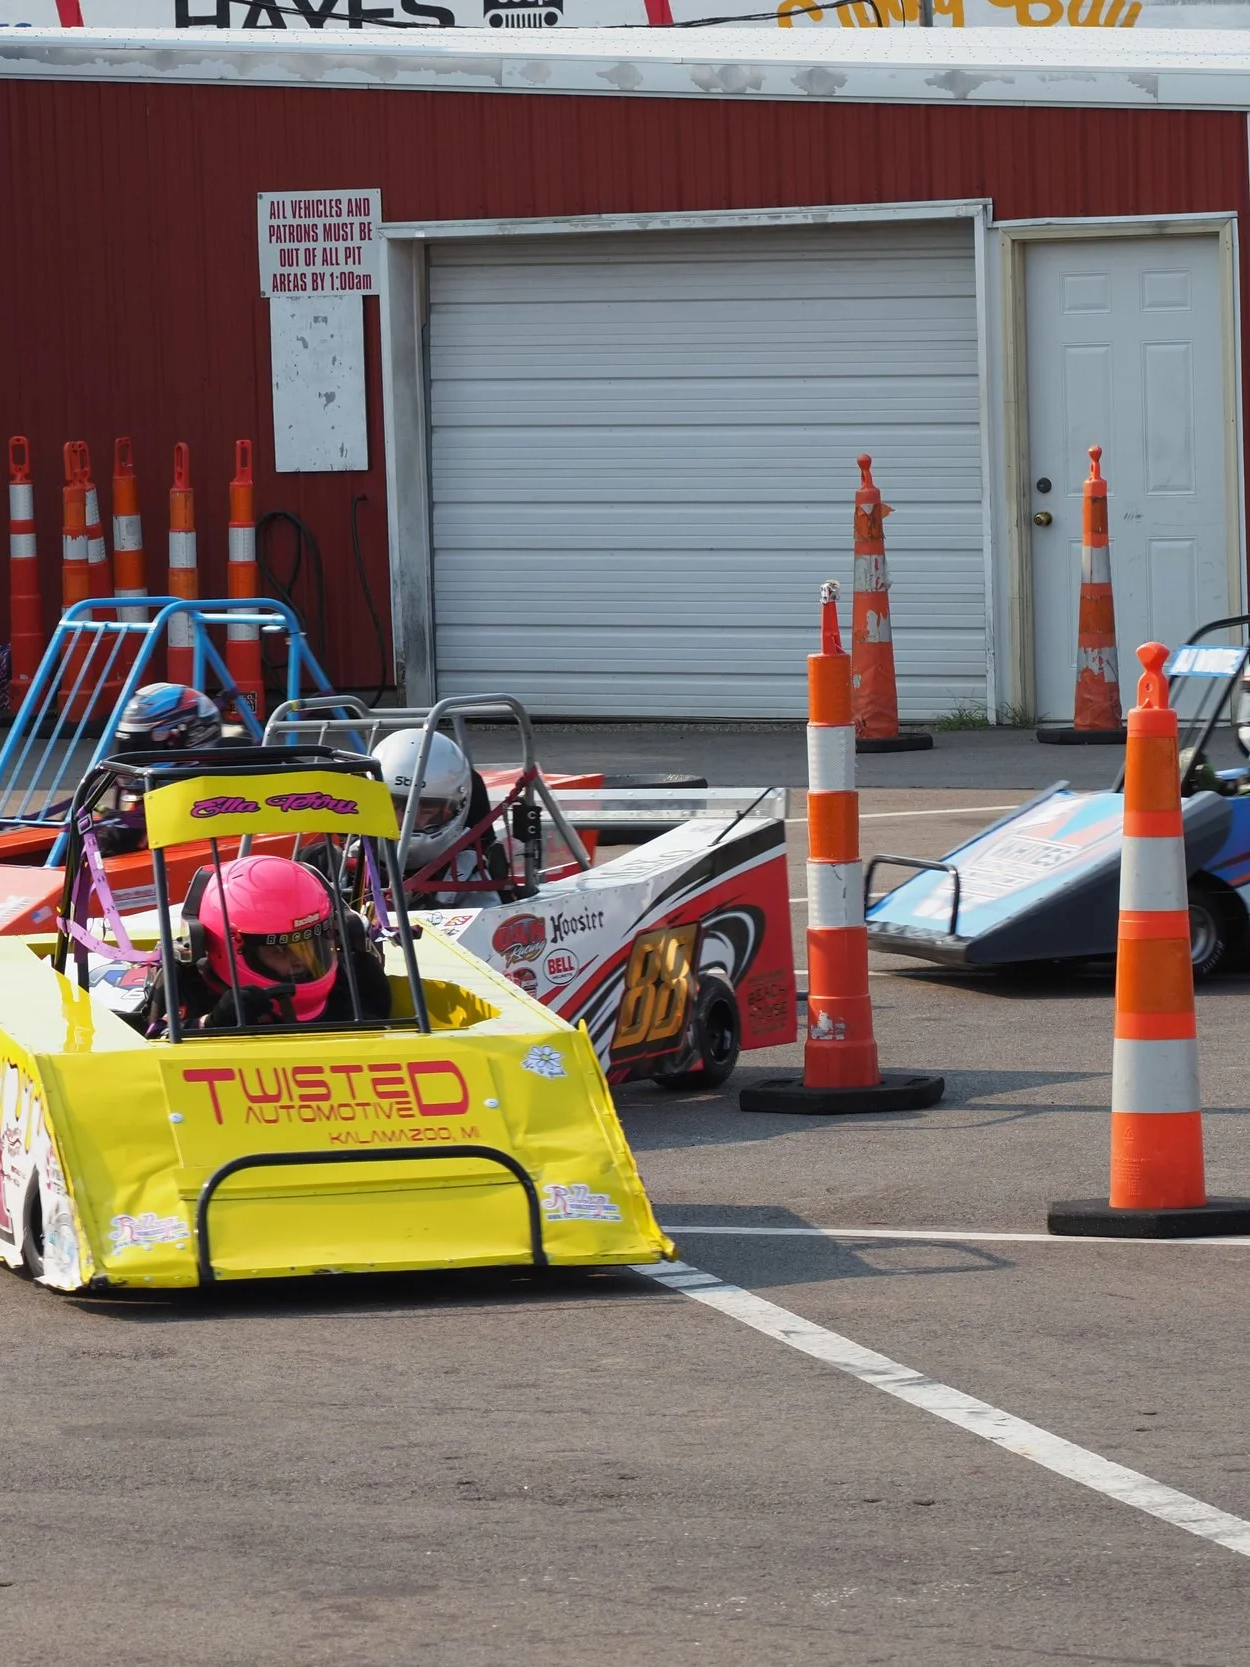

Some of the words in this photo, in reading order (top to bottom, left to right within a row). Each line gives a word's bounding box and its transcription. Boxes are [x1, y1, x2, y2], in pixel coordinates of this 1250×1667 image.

[270, 201, 287, 220] ALL
[291, 199, 342, 219] VEHICLES
[347, 198, 370, 217] AND
[269, 224, 318, 244] PATRONS
[323, 222, 355, 242] MUST
[359, 221, 372, 241] BE
[280, 248, 300, 267] OUT
[304, 247, 317, 267] OF
[322, 247, 340, 266] ALL
[344, 246, 362, 265] PIT
[272, 273, 307, 292] AREAS
[311, 272, 325, 291] BY
[329, 271, 372, 291] 1:00am
[191, 796, 261, 818] Ella
[265, 792, 359, 815] Terry
[550, 906, 604, 944] Hoosier
[547, 955, 575, 975] BELL
[182, 1060, 470, 1125] TWISTED
[244, 1100, 416, 1125] AUTOMOTIVE
[328, 1126, 456, 1145] KALAMAZOO,
[459, 1125, 481, 1140] MI
